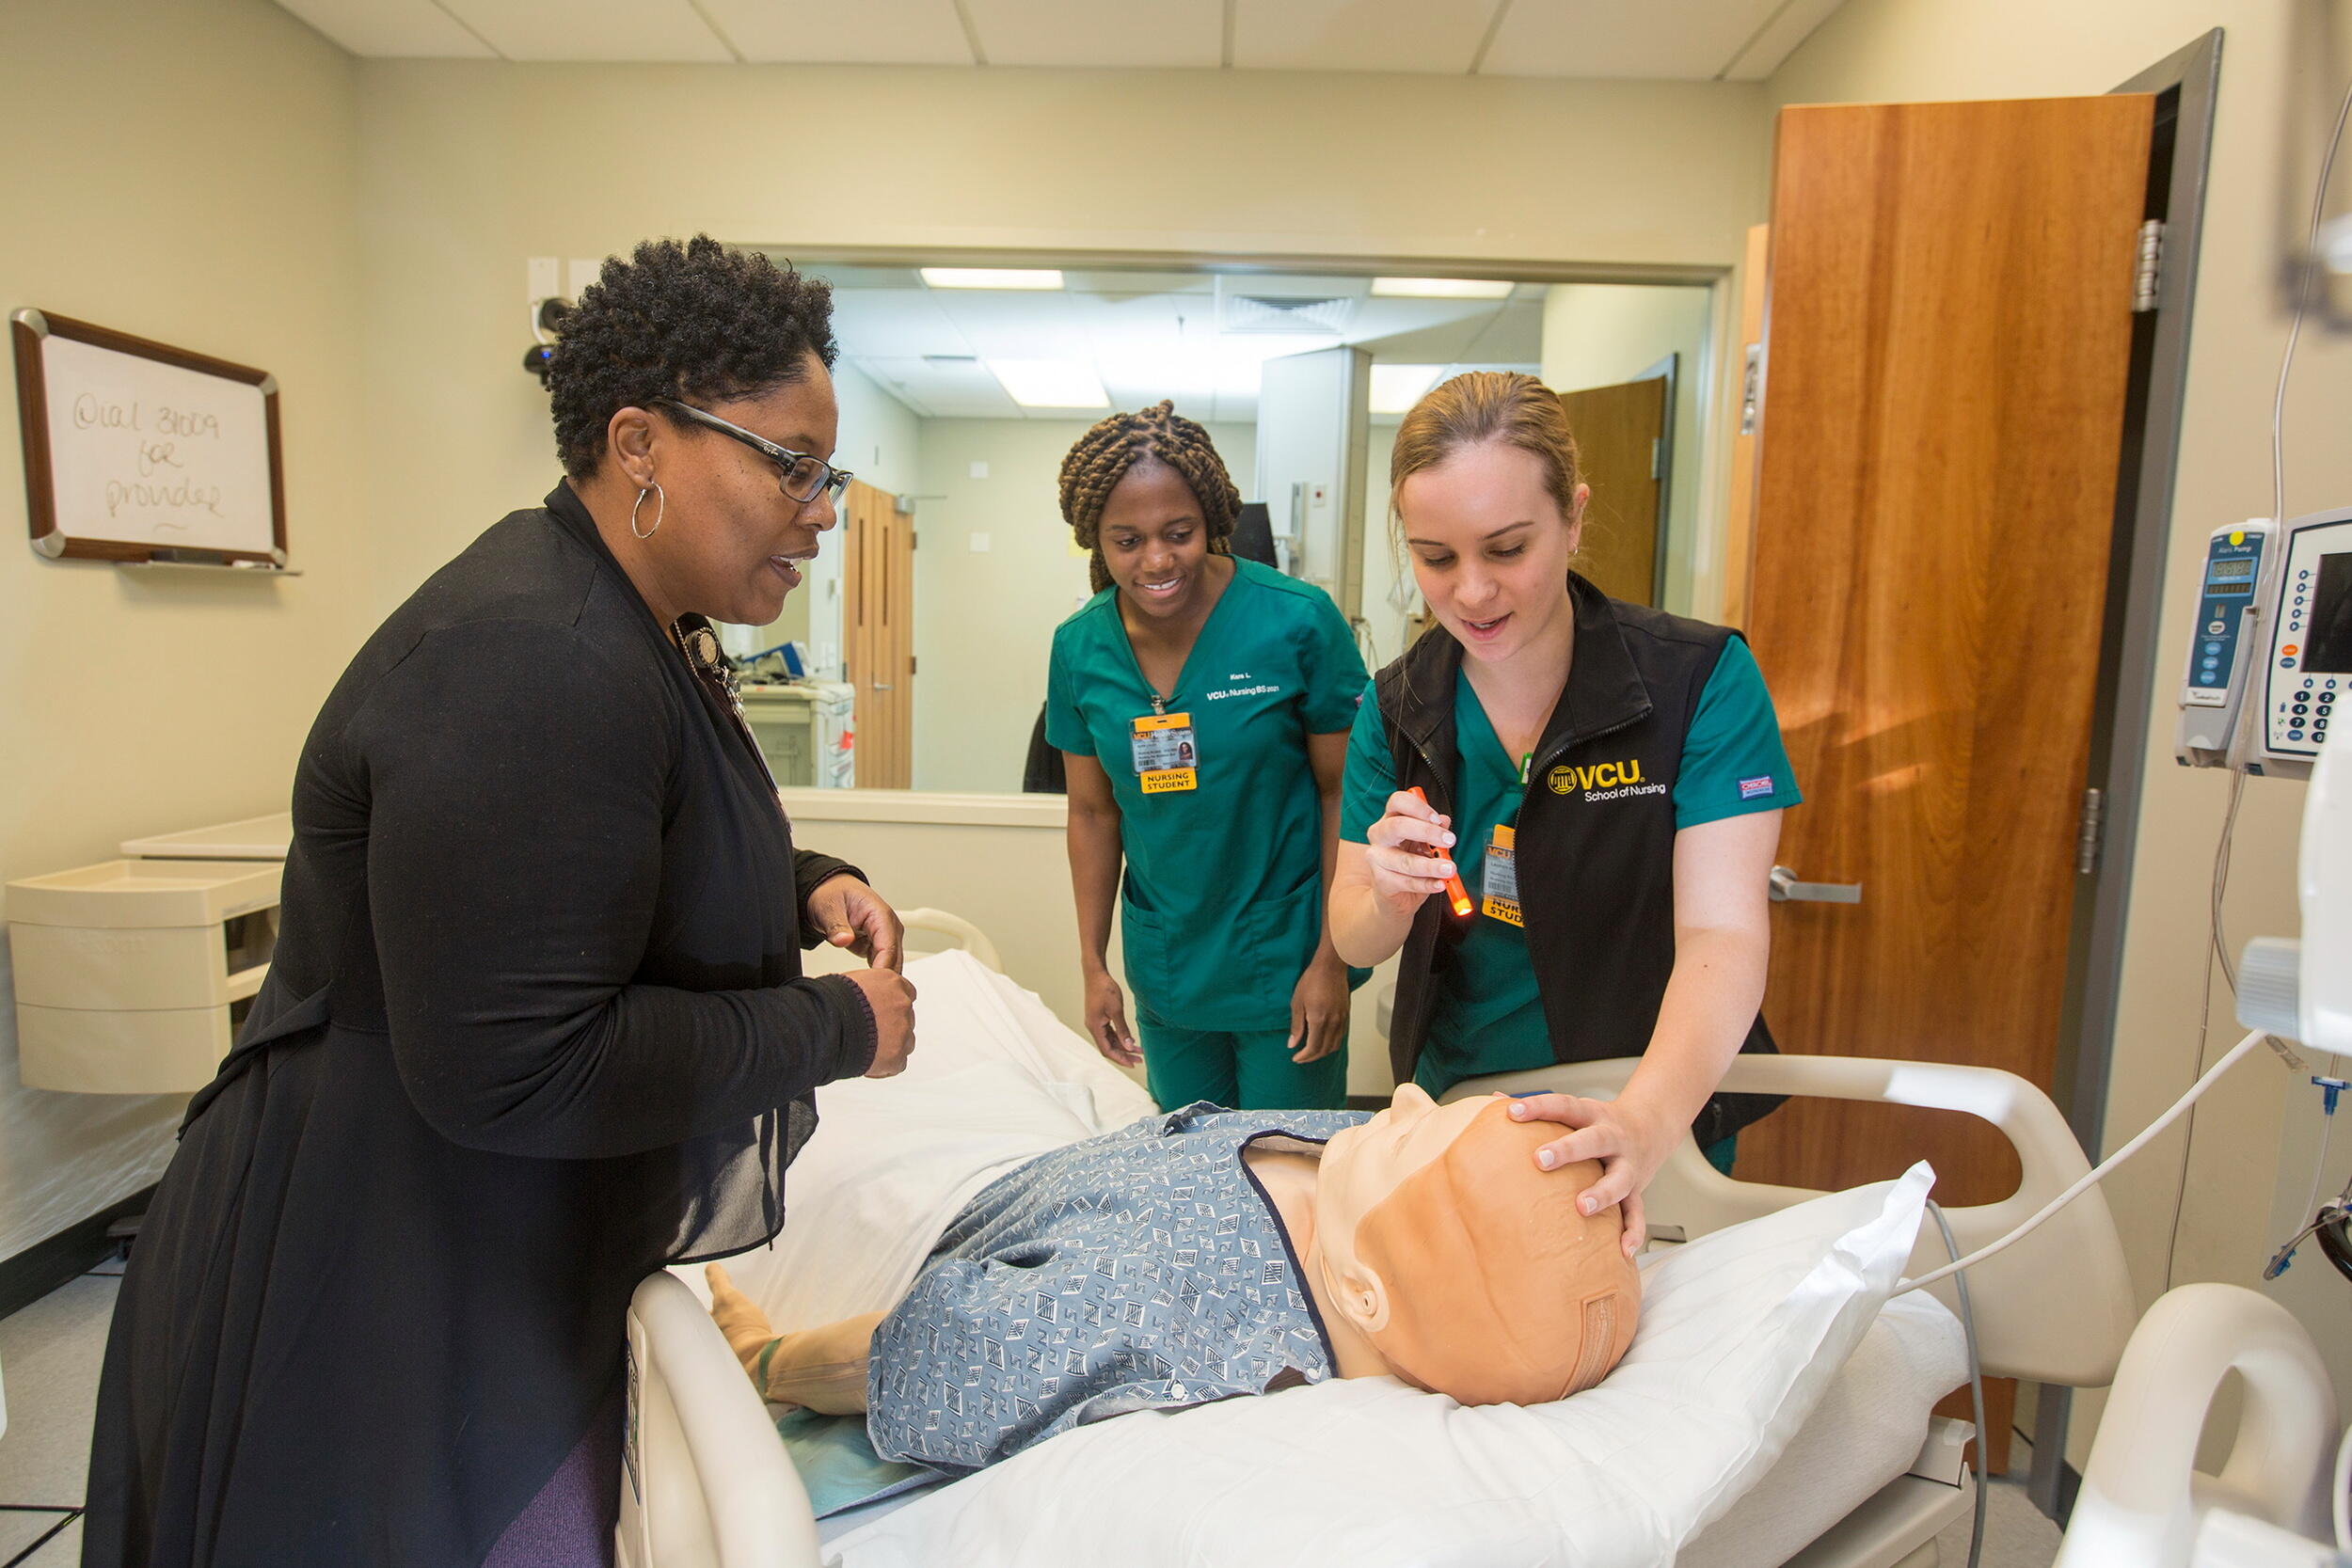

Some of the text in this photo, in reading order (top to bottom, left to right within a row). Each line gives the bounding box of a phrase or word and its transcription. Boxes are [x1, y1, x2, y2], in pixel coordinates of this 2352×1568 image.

[74, 393, 142, 430] Dial
[1206, 690, 1226, 701] VCU
[1229, 687, 1256, 696] Nursing
[1256, 685, 1266, 693] BS
[1148, 772, 1189, 782] NURSING
[1575, 759, 1640, 790] VCU
[1148, 780, 1190, 790] STUDENT
[1584, 783, 1666, 802] School of Nursing
